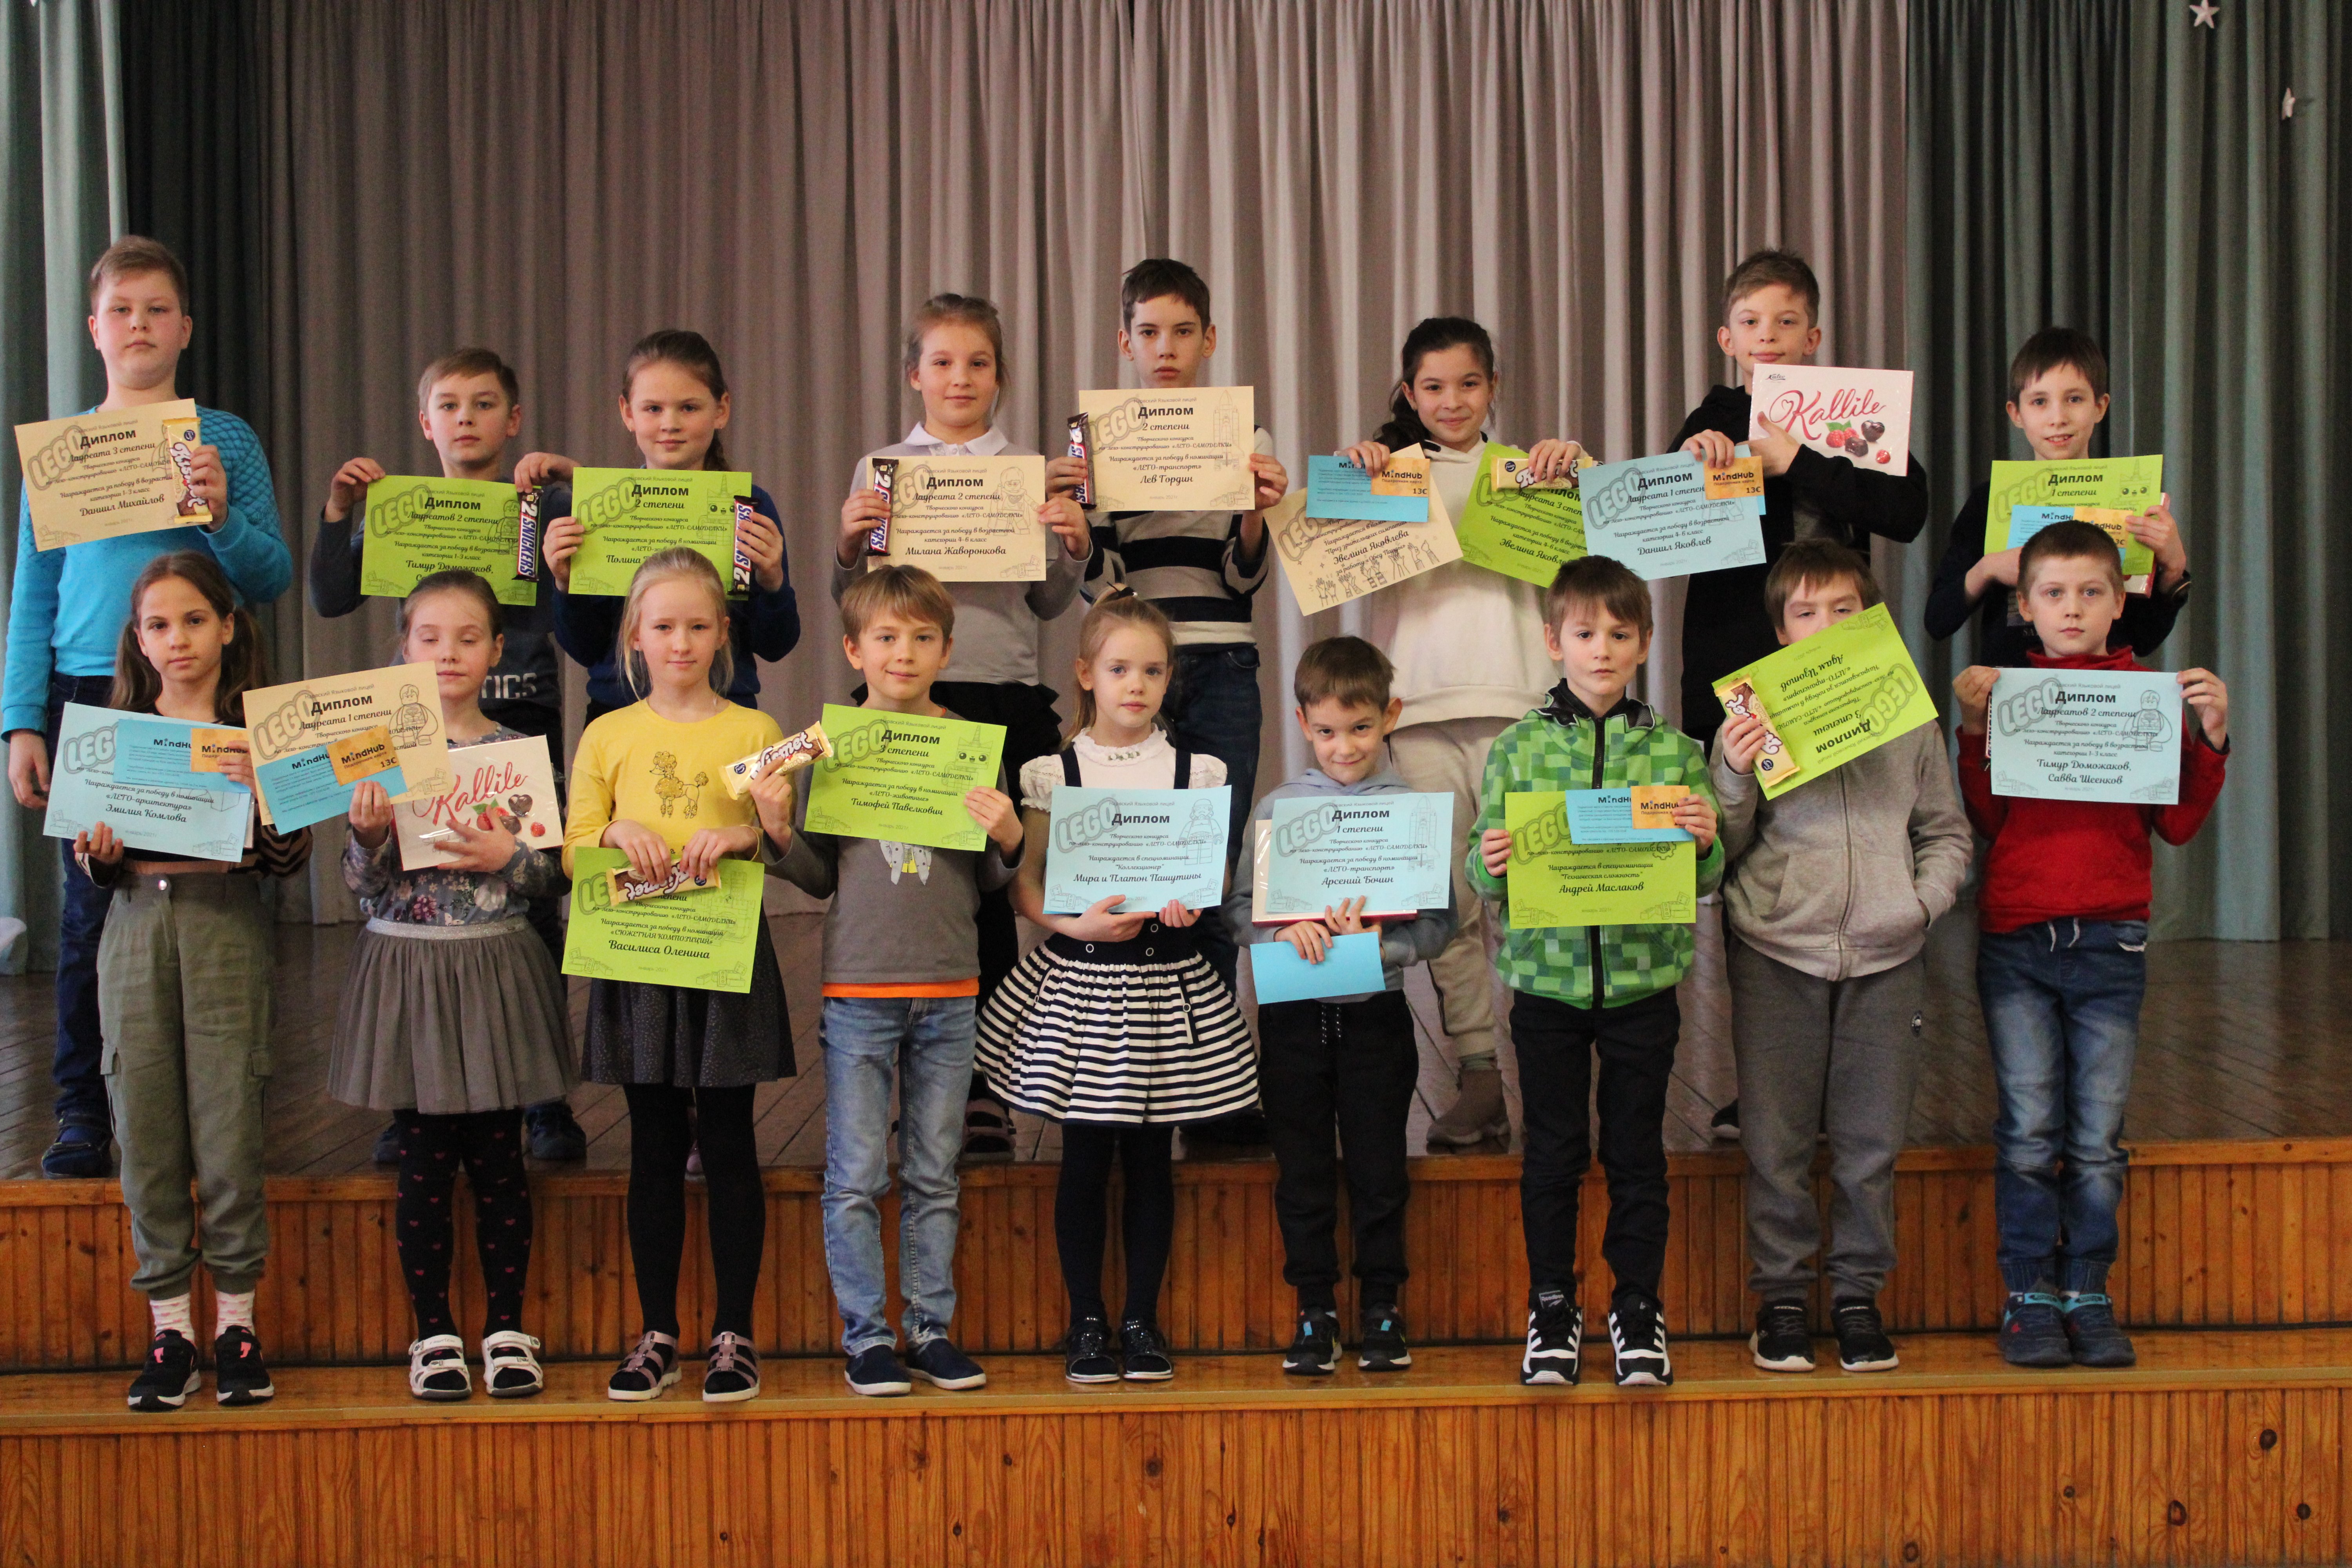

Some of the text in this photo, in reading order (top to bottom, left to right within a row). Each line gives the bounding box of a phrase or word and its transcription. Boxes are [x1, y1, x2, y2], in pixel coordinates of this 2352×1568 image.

[1138, 407, 1193, 419] Диплом
[1769, 389, 1886, 440] Kallile
[80, 430, 136, 449] Диплом
[29, 426, 88, 490] LEGO
[68, 449, 110, 464] Лауреата
[120, 443, 155, 454] степени
[927, 477, 983, 490] Диплом
[1141, 475, 1193, 486] Лев Гордин
[1638, 472, 1692, 490] Диплом
[2048, 474, 2103, 486] Диплом
[632, 485, 689, 497] Диплом
[912, 493, 956, 503] Лауреата
[1587, 467, 1646, 530] LEGO
[1627, 492, 1668, 504] Лауреата
[1675, 485, 1704, 495] степен
[80, 494, 165, 517] Даниил Михайлов
[371, 485, 431, 538] LEGO
[425, 497, 481, 510] Диплом
[643, 501, 684, 509] степени
[407, 512, 455, 521] Лауреатов
[519, 518, 537, 577] SNICKERS
[944, 546, 1006, 557] Жаворонкова
[1333, 530, 1409, 565] Эвелина Яковлева
[1500, 539, 1534, 555] Эвелина
[1638, 537, 1712, 555] Даниил Яковлев
[606, 555, 641, 564] Полина
[1343, 560, 1365, 573] работу
[1780, 654, 1843, 692] Адам Изотов
[311, 696, 372, 715] Диплом
[2055, 691, 2116, 704] Диплом
[1998, 678, 2064, 736] LEGO
[2037, 708, 2088, 718] Лауреатов
[254, 690, 321, 760] LEGO
[299, 717, 346, 731] Лауреата
[353, 709, 392, 720] степени
[1813, 716, 1853, 736] степени
[881, 730, 940, 745] Диплом
[1816, 718, 1870, 753] Диплом
[887, 747, 929, 758] степени
[876, 758, 909, 767] Творческого
[2037, 759, 2069, 769] Тимур
[2048, 774, 2122, 784] Савва Шеенков
[842, 778, 886, 789] Награждается
[896, 784, 916, 793] победу
[924, 788, 958, 797] номинации
[106, 804, 186, 822] Эмилия Комлова
[851, 798, 943, 815] Тимофей Павелкович
[1112, 813, 1170, 825] Диплом
[1332, 810, 1390, 822] Диплом
[1056, 797, 1120, 853] LEGO
[1276, 802, 1340, 857] LEGO
[1074, 875, 1099, 885] Мира
[1150, 873, 1201, 884] Пашутины
[1321, 875, 1393, 887] Арсений Бочин
[1559, 882, 1644, 896] Андрей Маслаков
[609, 940, 710, 959] Василиса Оленина
